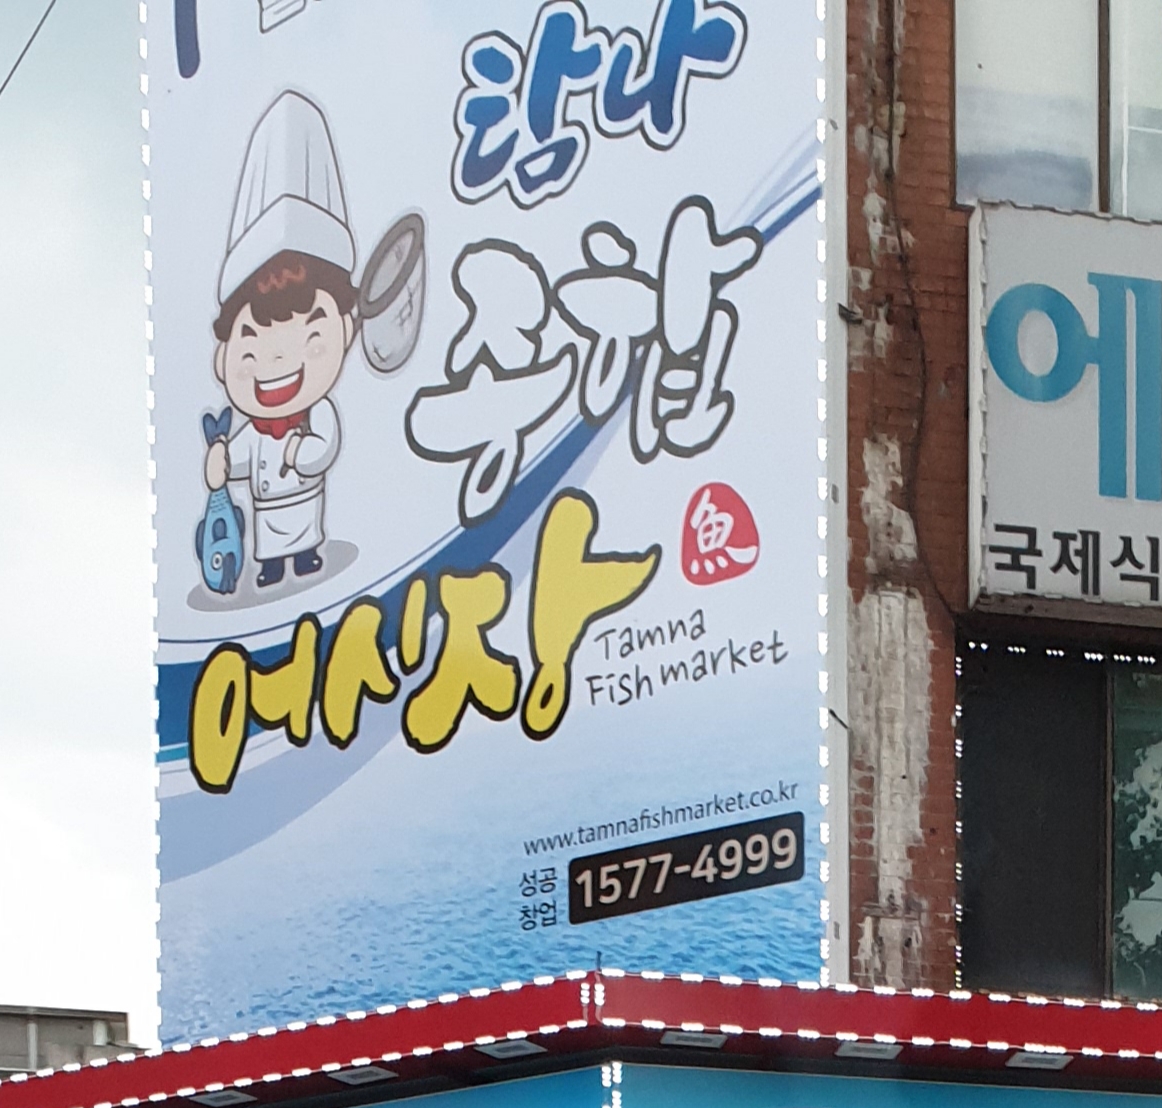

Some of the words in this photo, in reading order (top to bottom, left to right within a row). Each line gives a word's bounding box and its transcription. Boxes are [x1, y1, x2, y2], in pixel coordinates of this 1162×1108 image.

[686, 490, 758, 578] 魚
[988, 523, 1161, 601] 국제식
[189, 487, 662, 794] 어시장
[585, 671, 654, 706] Fish
[658, 629, 790, 683] market
[594, 608, 707, 661] Tamna
[523, 781, 799, 856] www.tamnafishmarket.co.kr
[518, 867, 558, 896] 성공
[575, 827, 798, 909] 1577-4999
[518, 899, 558, 931] 창업
